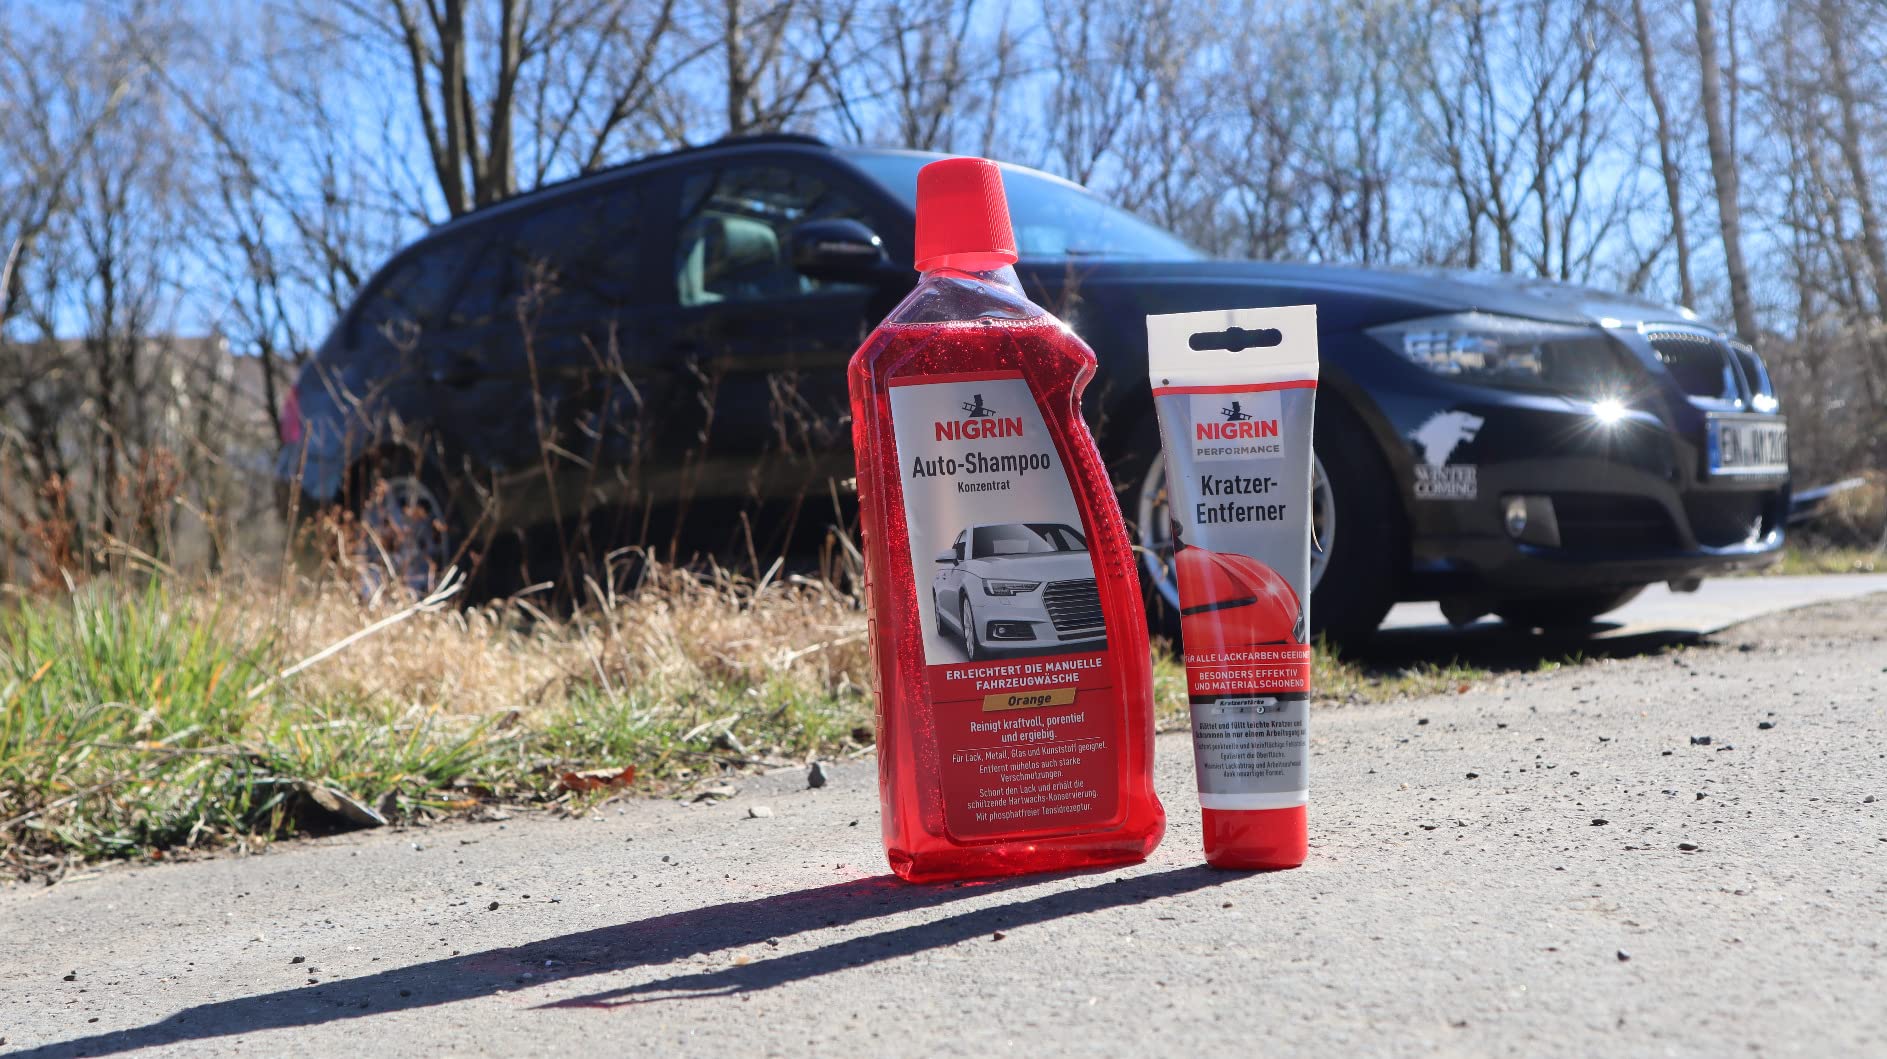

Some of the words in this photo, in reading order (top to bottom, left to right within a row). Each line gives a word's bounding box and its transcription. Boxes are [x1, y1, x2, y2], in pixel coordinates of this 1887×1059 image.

[935, 417, 1023, 441] NIGRIN
[1196, 420, 1278, 440] NIGRIN
[1197, 444, 1280, 456] PERFORMANCE
[912, 452, 1050, 478] Auto-Shampoo
[958, 480, 1010, 493] Konzentrat
[1202, 474, 1278, 496] Kratzer-
[1196, 502, 1286, 524] Entferner
[1196, 654, 1216, 662] ALLE
[1218, 652, 1278, 661] LACKFARBEN
[1281, 650, 1310, 659] GEEIGNE
[946, 665, 1021, 680] ERLEICHTERT
[1025, 663, 1042, 674] DIE
[1046, 658, 1102, 672] MANUELLE
[1200, 670, 1252, 680] BESONDERS
[1256, 668, 1298, 678] EFFEKTIV
[976, 672, 1079, 690] FAHRZEUGWÄSCHE
[1194, 682, 1210, 690] UND
[1008, 694, 1052, 706] Orange
[970, 720, 1001, 733] Reinigt
[1004, 716, 1044, 730] kraftvoll,
[1046, 712, 1085, 727] porentief
[1001, 732, 1018, 743] und
[1020, 730, 1057, 742] ergiebig.
[952, 753, 962, 763] Für
[966, 752, 984, 763] Lack,
[986, 750, 1010, 760] Metall,
[1012, 748, 1026, 758] Glas
[1028, 748, 1040, 757] und
[979, 762, 1008, 774] Entfernt
[1010, 760, 1039, 772] mühelos
[1042, 758, 1058, 768] auch
[1059, 756, 1080, 767] starke
[1000, 770, 1064, 784] Verschmutzungen.
[979, 787, 1004, 798] Schont
[1006, 786, 1018, 796] den
[1020, 784, 1036, 794] Lack
[1038, 782, 1050, 792] und
[1074, 780, 1084, 788] die
[976, 811, 988, 822] Mit
[990, 808, 1040, 822] phosphatfreier
